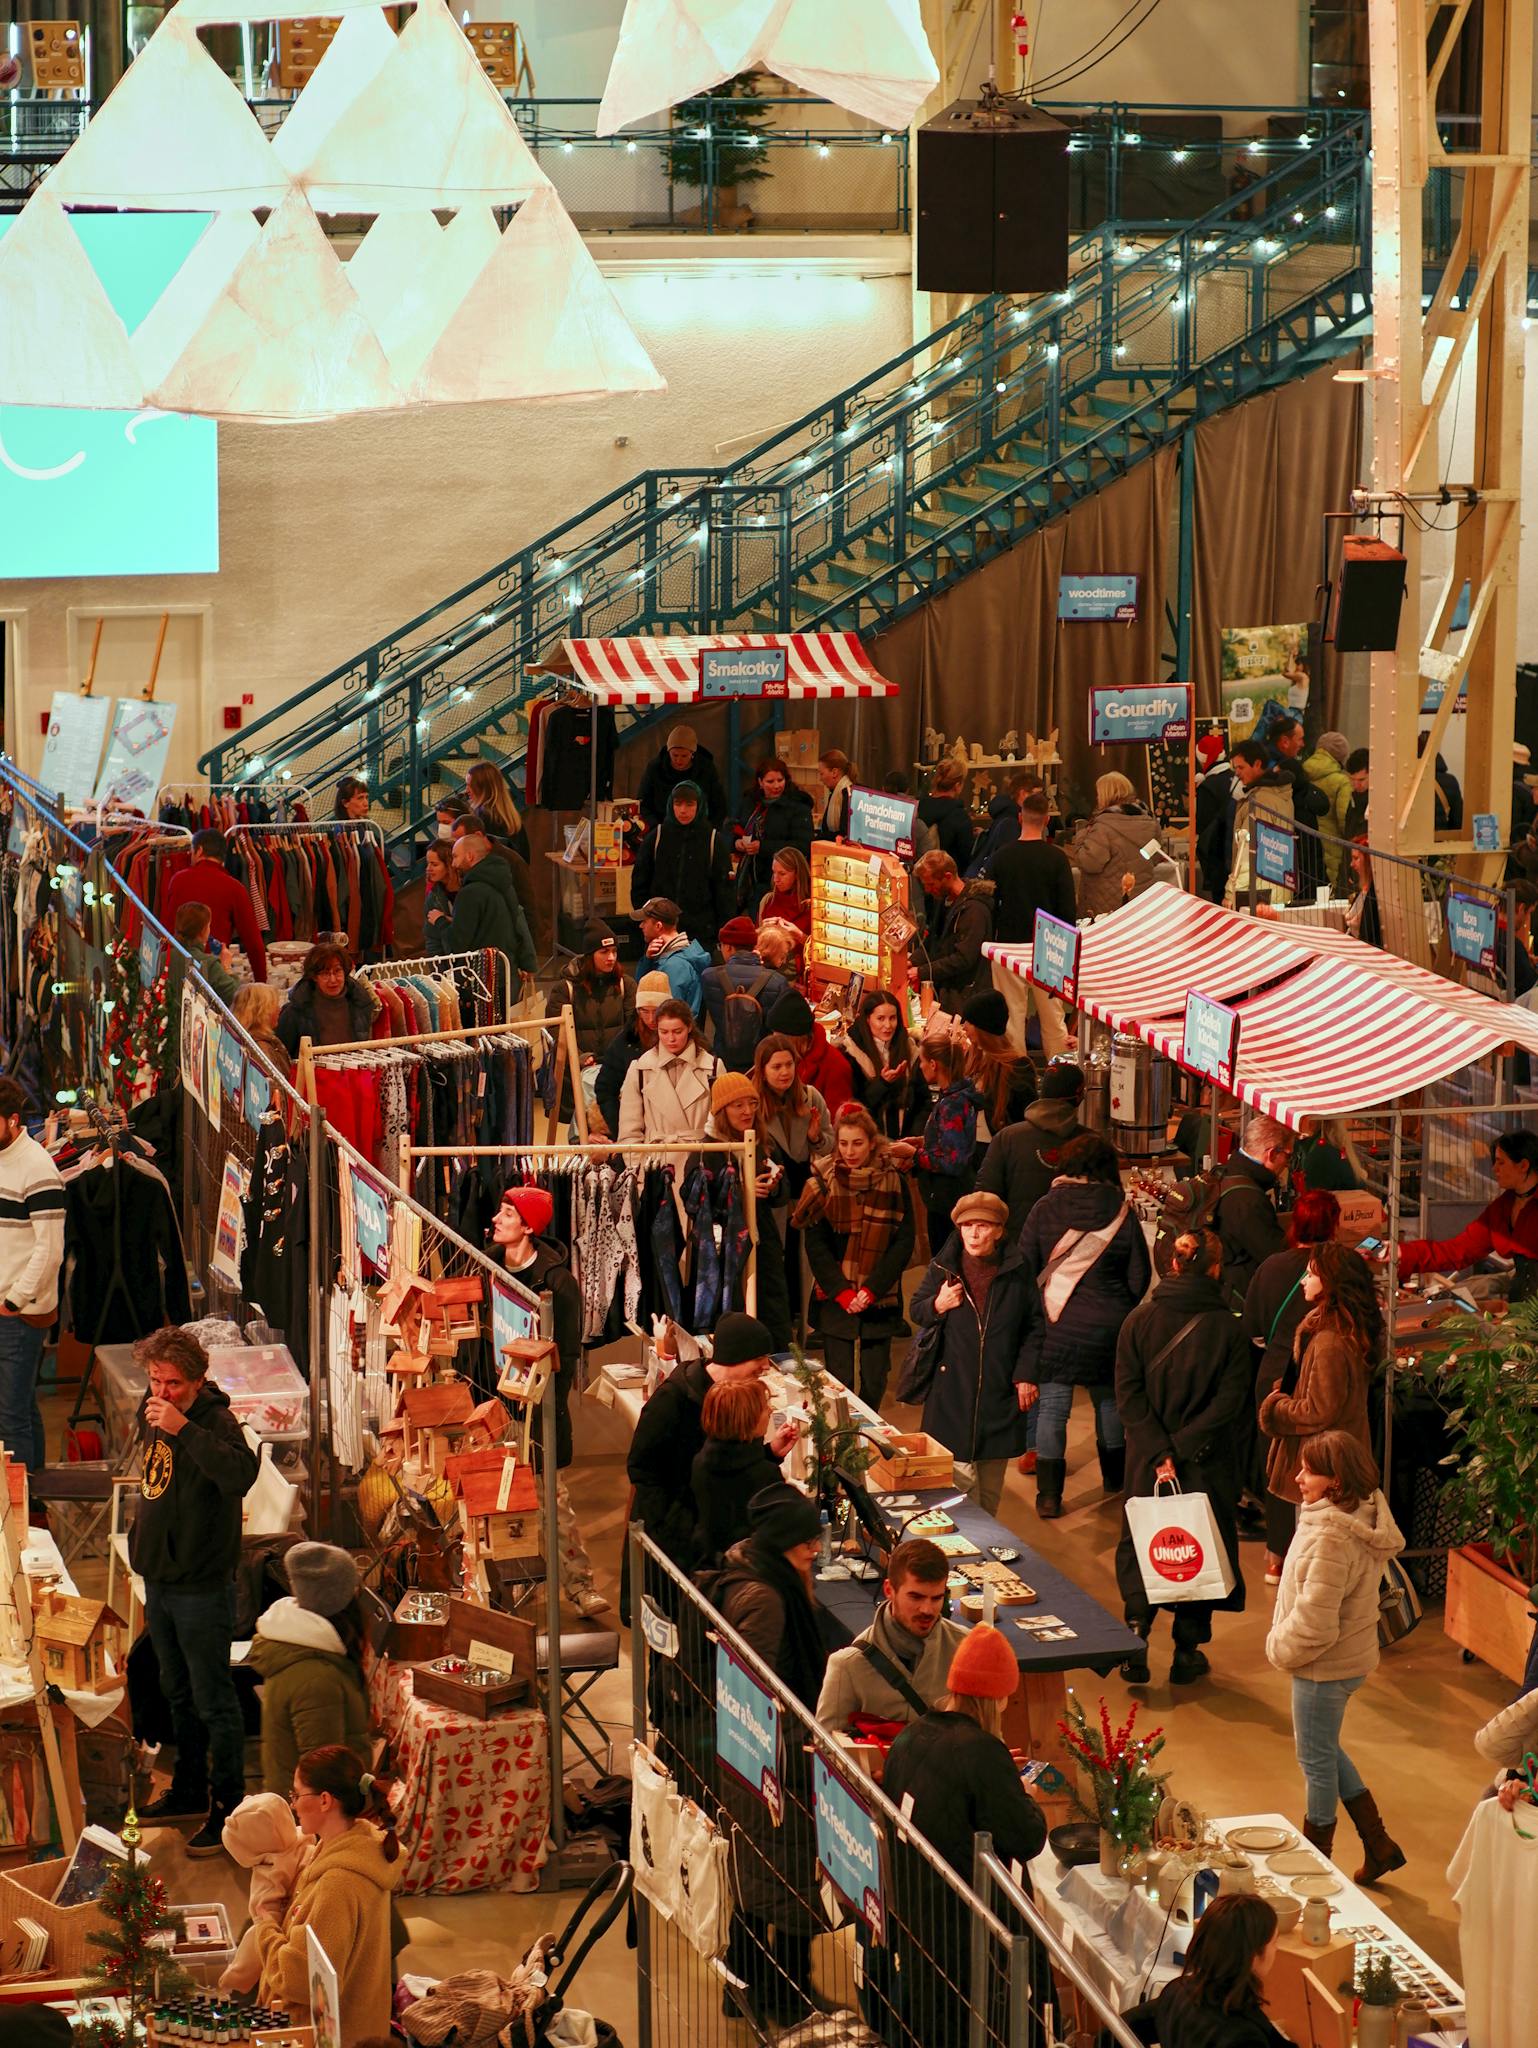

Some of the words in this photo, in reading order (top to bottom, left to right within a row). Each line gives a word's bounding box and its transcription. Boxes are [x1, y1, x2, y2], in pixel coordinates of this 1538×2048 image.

[1068, 588, 1127, 598] woodtimes
[708, 660, 780, 679] Šmakotky
[1104, 699, 1179, 719] Gourdify
[857, 799, 906, 823] Anandoham
[1162, 1536, 1167, 1547] I
[1168, 1534, 1186, 1546] AM
[1153, 1544, 1198, 1563] UNIQUE
